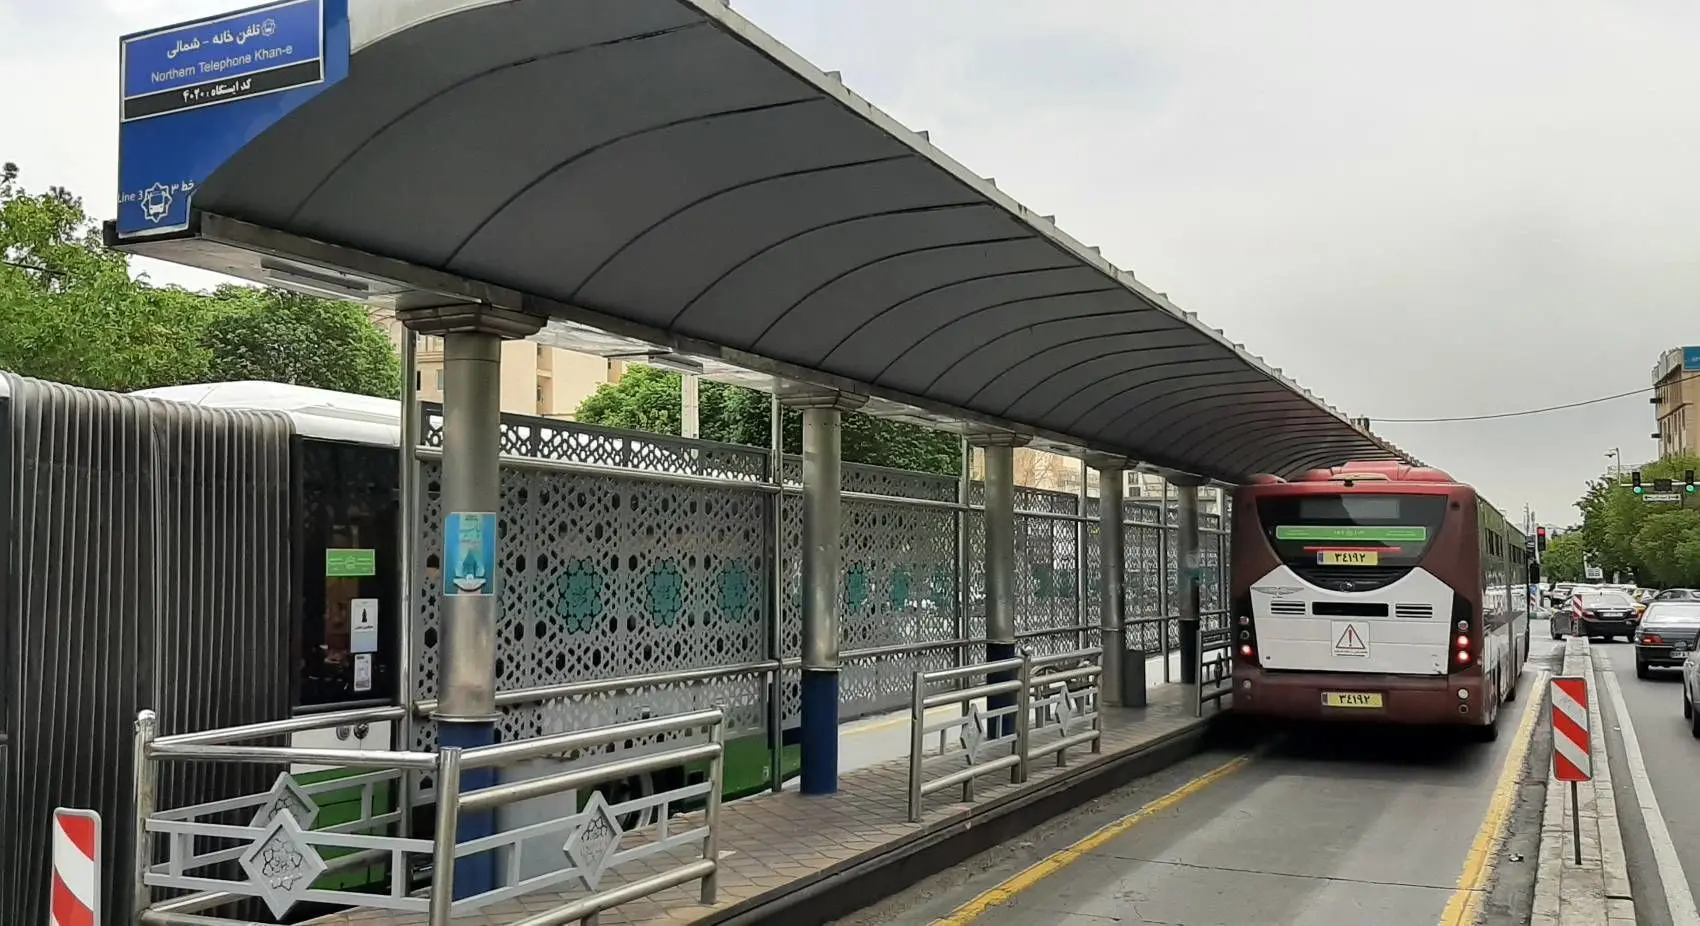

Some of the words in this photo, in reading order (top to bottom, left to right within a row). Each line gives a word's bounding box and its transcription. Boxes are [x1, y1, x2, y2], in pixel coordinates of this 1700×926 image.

[212, 30, 234, 45] خانه
[236, 23, 261, 45] تلفن
[166, 37, 201, 59] شمالی
[151, 66, 196, 84] Northern
[199, 53, 252, 73] Telephone
[254, 45, 293, 62] Khan-e
[117, 191, 136, 204] Line
[138, 190, 143, 201] 3
